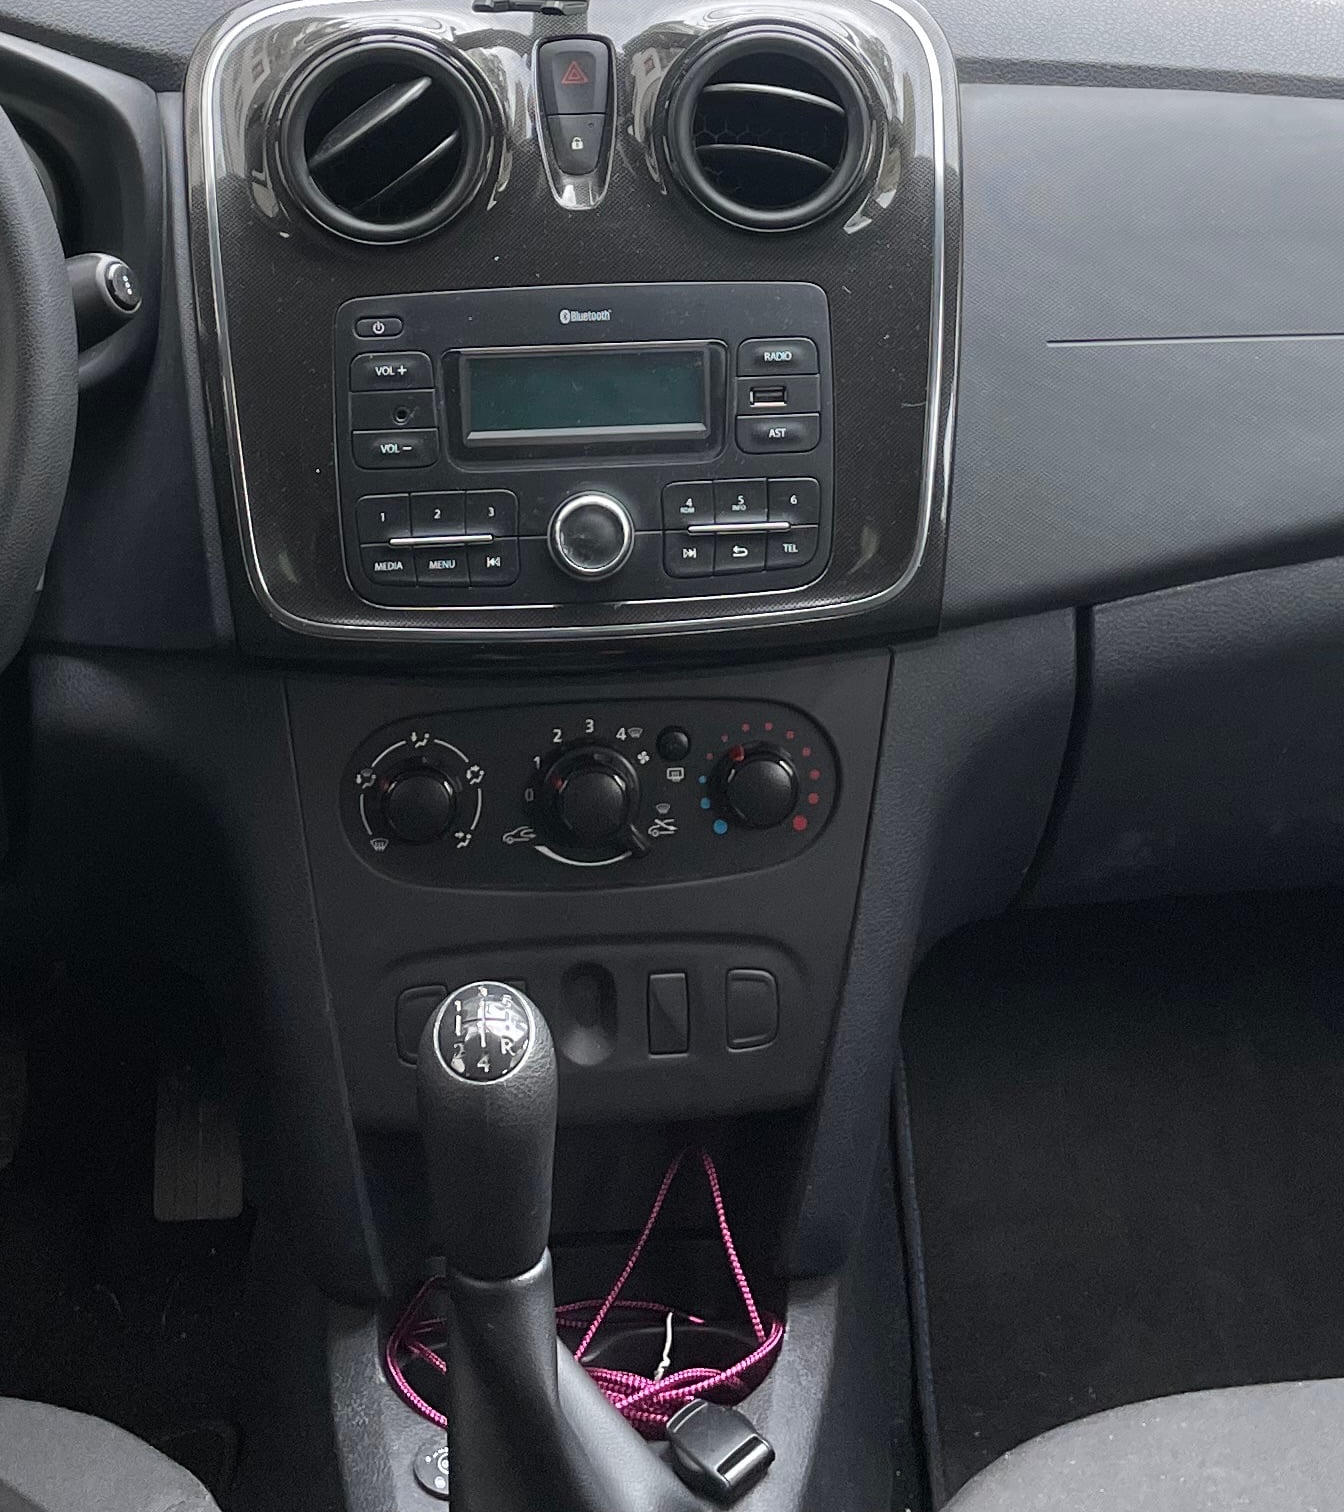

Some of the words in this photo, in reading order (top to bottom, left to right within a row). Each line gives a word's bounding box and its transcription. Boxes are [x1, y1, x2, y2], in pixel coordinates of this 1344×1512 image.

[570, 309, 611, 322] Bluetooth
[763, 351, 792, 362] RADIO
[375, 366, 395, 377] VOL
[768, 428, 786, 438] AST
[380, 443, 400, 454] VOL
[685, 498, 692, 507] 4
[738, 495, 745, 505] 5
[790, 494, 797, 505] 6
[380, 512, 385, 522] 1
[434, 509, 441, 519] 2
[488, 506, 495, 517] 3
[782, 543, 799, 553] TEL
[374, 561, 404, 571] MEDIA
[428, 560, 456, 570] MENU
[585, 718, 595, 733] 3
[552, 728, 562, 743] 2
[616, 727, 627, 741] 4
[533, 756, 541, 770] 1
[500, 1035, 516, 1056] R
[477, 1054, 491, 1073] 4
